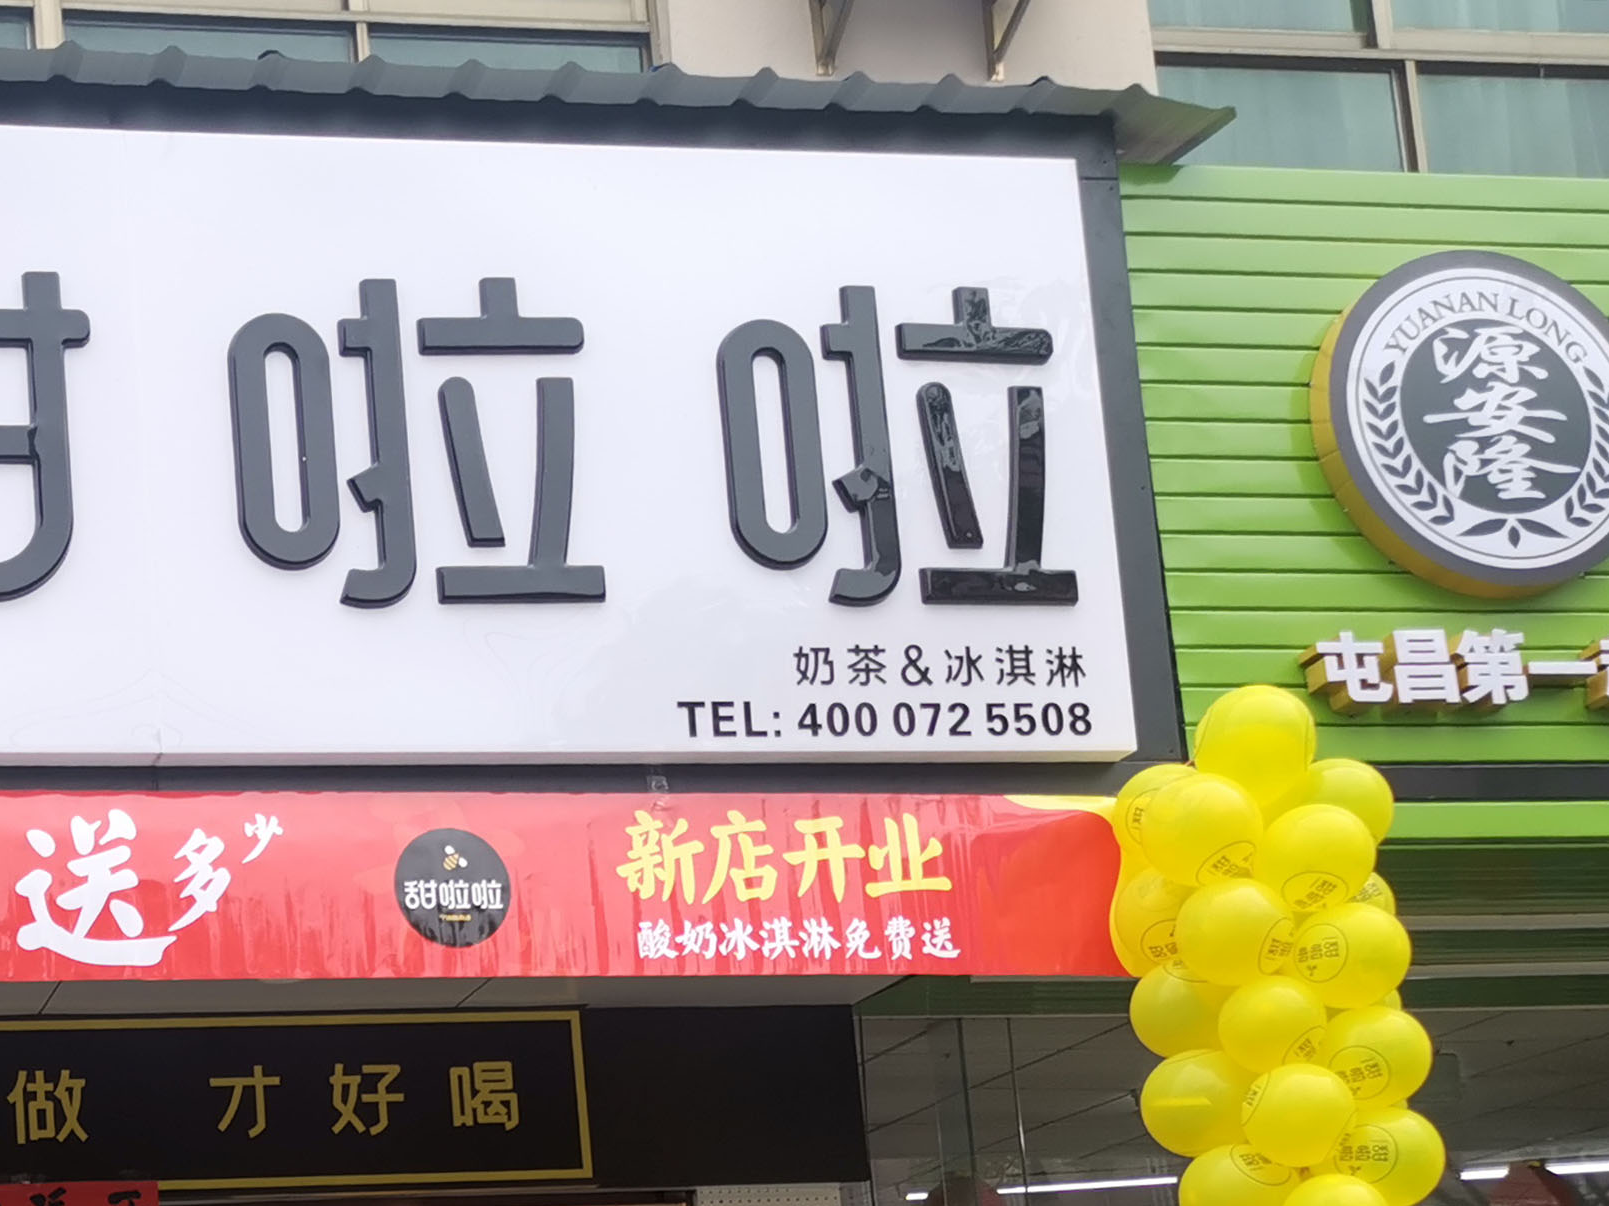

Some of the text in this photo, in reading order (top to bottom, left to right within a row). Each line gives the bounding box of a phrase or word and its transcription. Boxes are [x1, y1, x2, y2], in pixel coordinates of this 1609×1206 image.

[1384, 290, 1588, 365] YUANAN LONG
[792, 644, 1087, 688] 奶茶&冰淇淋
[677, 701, 1093, 737] TEL: 400 072 5508
[616, 810, 953, 905] 新店开业
[403, 878, 504, 911] 甜啦啦
[637, 915, 961, 961] 酸奶冰淇淋免费送
[208, 1060, 521, 1139] 才好喝
